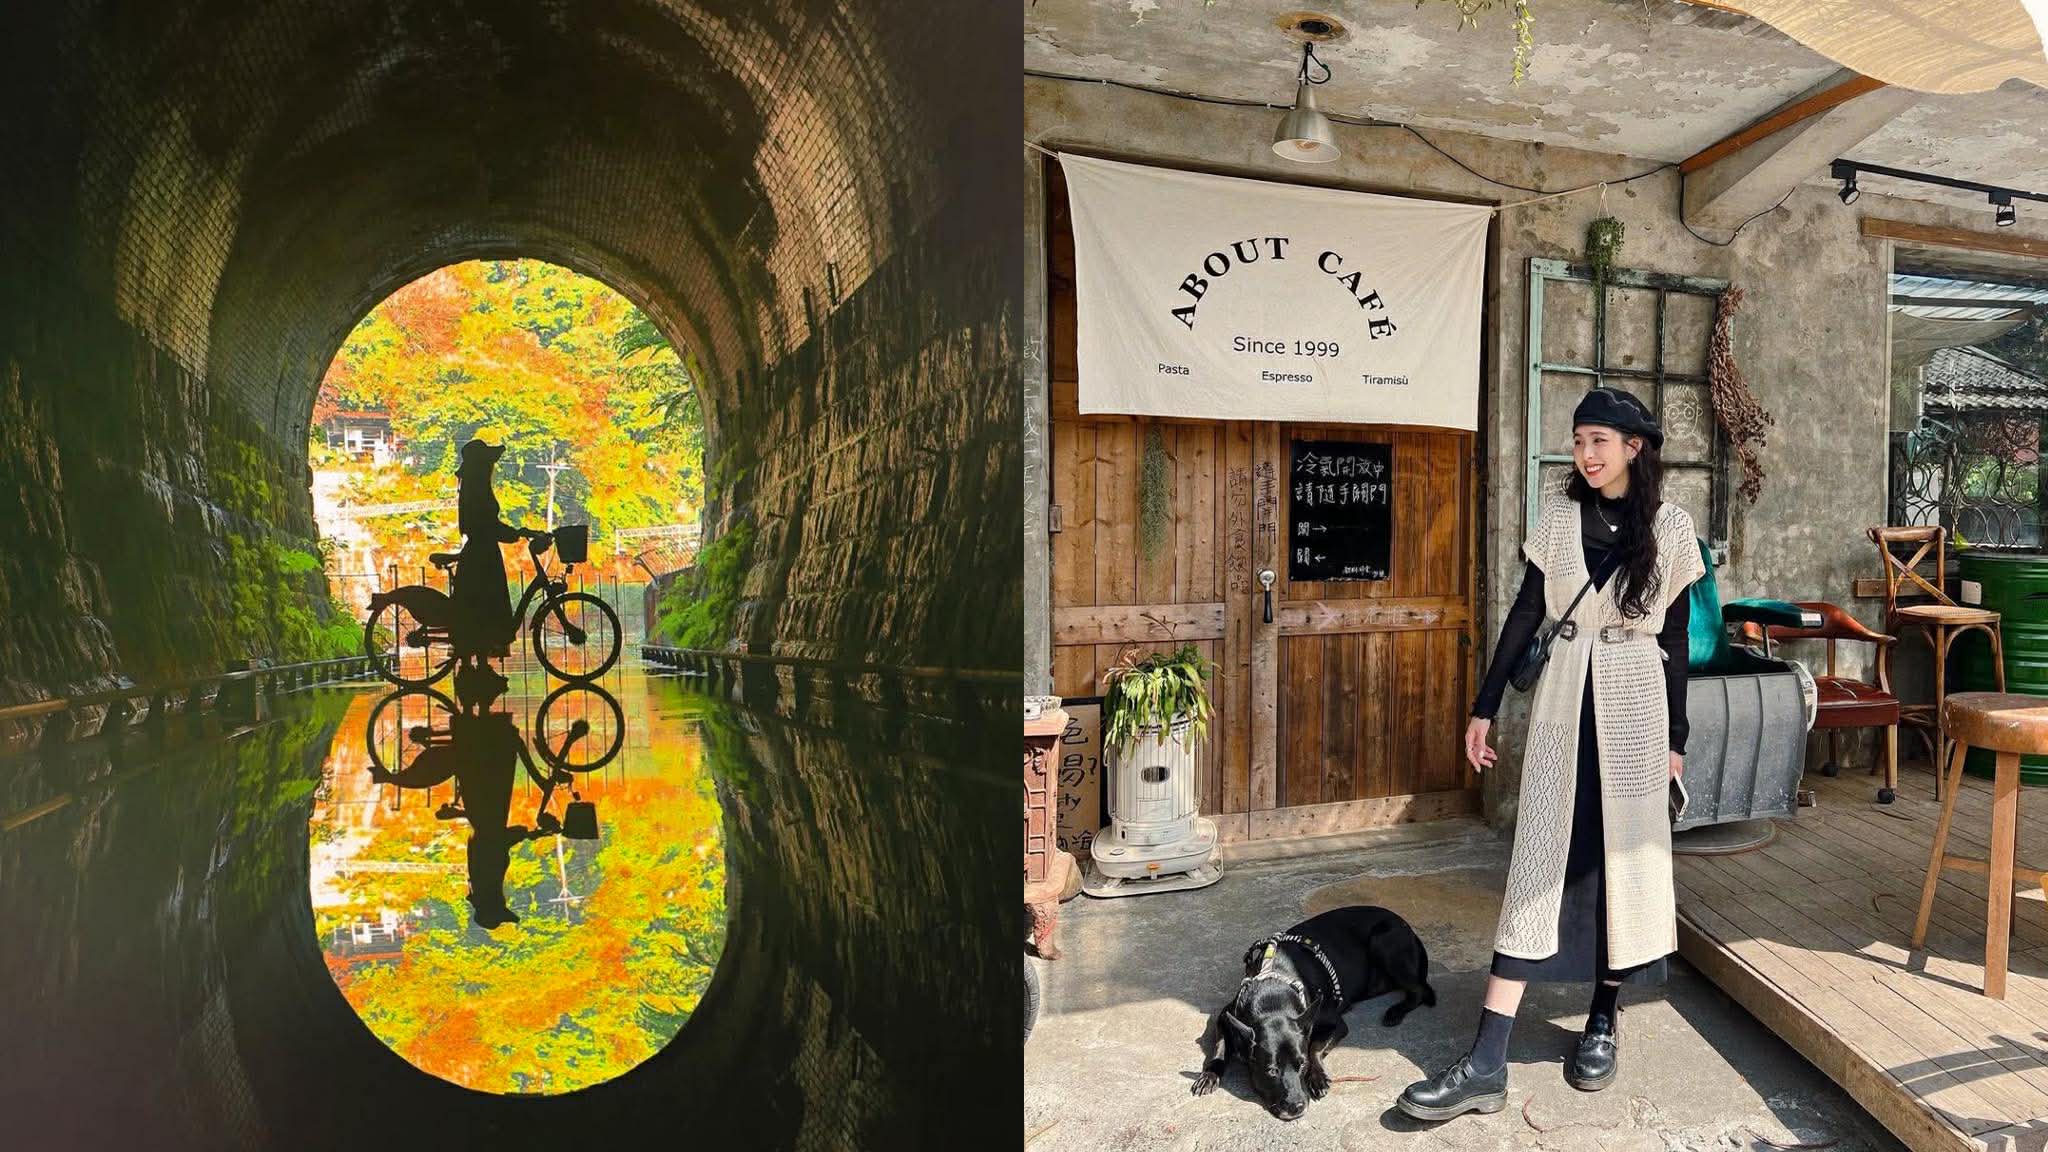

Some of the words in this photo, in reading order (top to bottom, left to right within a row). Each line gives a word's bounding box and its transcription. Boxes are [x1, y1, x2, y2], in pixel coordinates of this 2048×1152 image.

[1171, 237, 1290, 331] ABOUT
[1317, 250, 1398, 341] CAFÉ
[1233, 336, 1286, 355] Since
[1294, 340, 1340, 358] 1999
[1158, 363, 1190, 376] Pasta
[1262, 370, 1313, 384] Espresso
[1362, 374, 1409, 386] Tiramisù
[1296, 451, 1385, 479] 冷氣開放中
[1295, 481, 1387, 507] 請隨手關門
